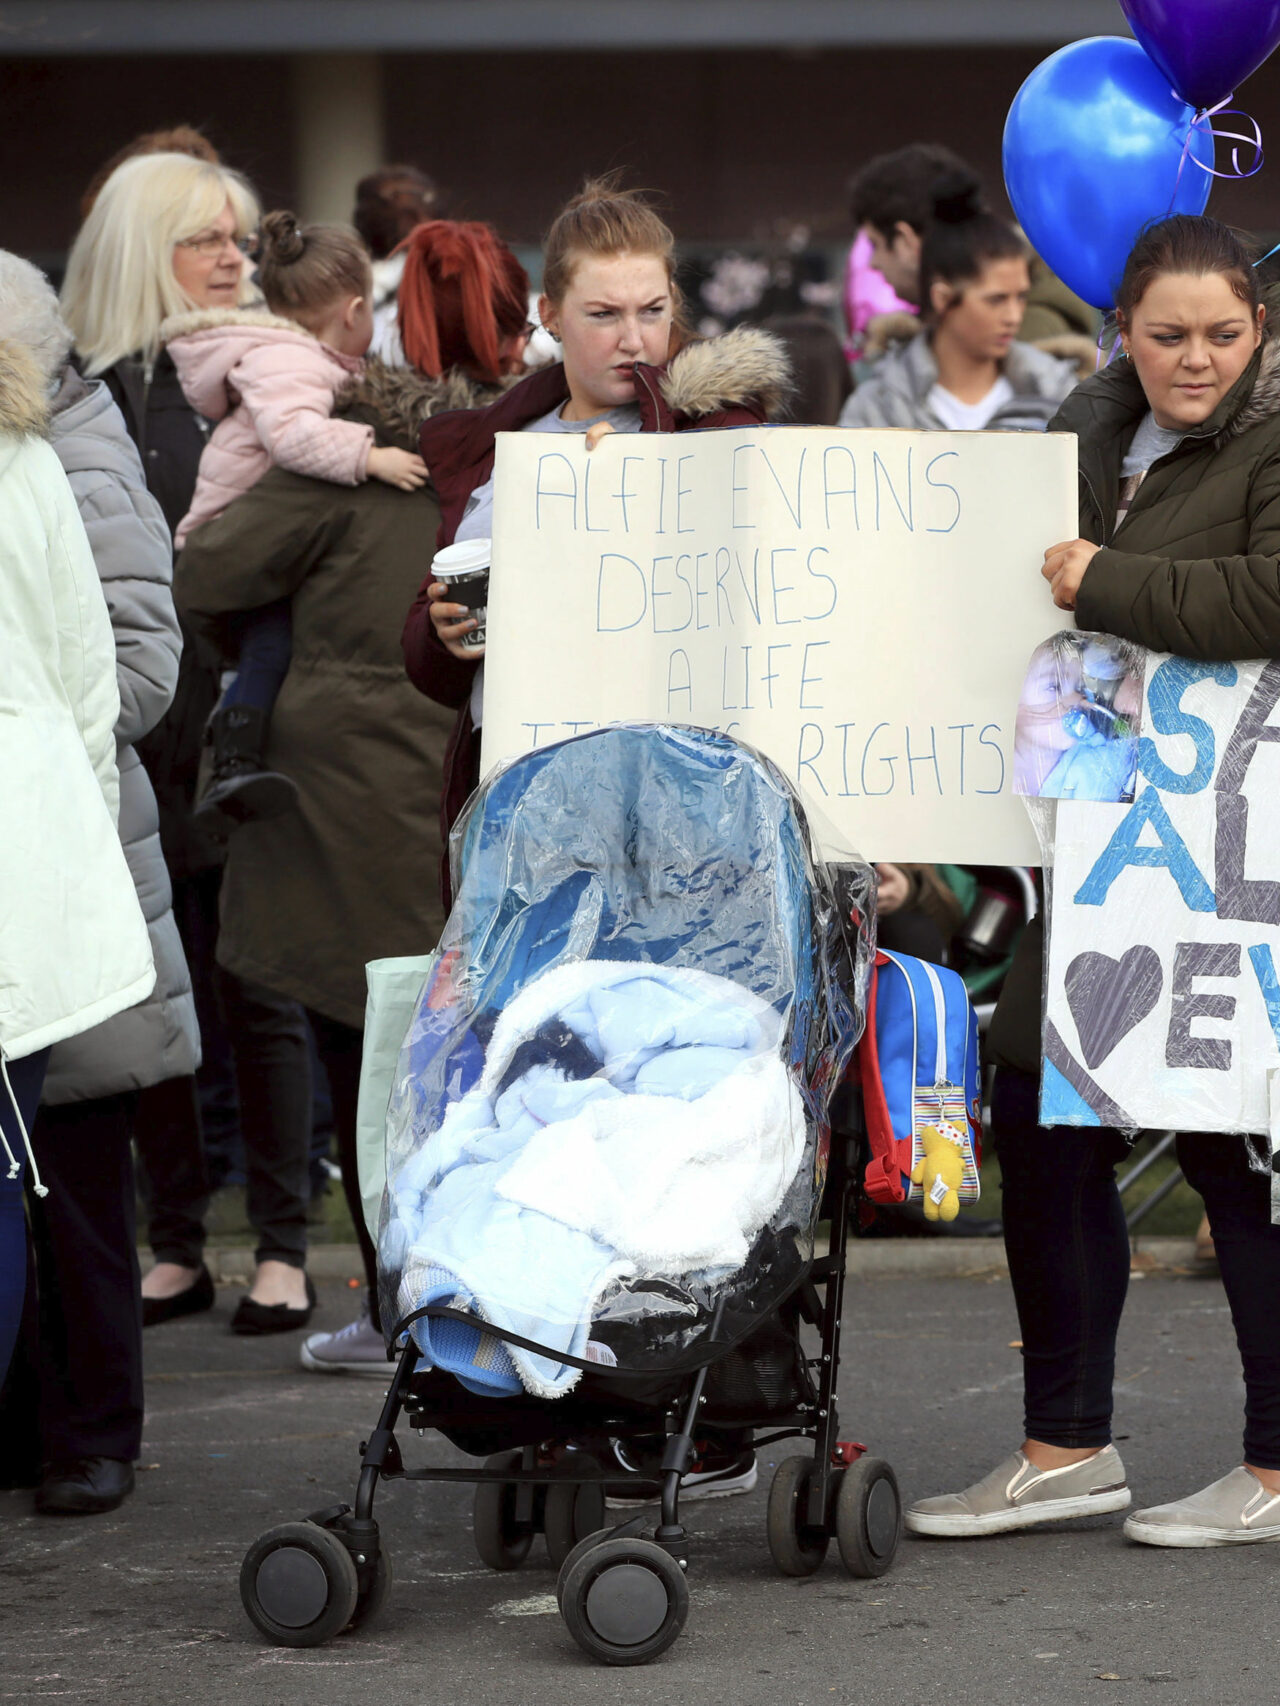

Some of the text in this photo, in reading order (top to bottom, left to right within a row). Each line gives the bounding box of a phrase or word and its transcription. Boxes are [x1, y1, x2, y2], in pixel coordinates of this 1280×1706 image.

[536, 444, 961, 534] ALFIE EVANS
[596, 546, 837, 633] DESERVES
[667, 641, 831, 714] A LIFE
[798, 722, 1005, 797] RIGHTS
